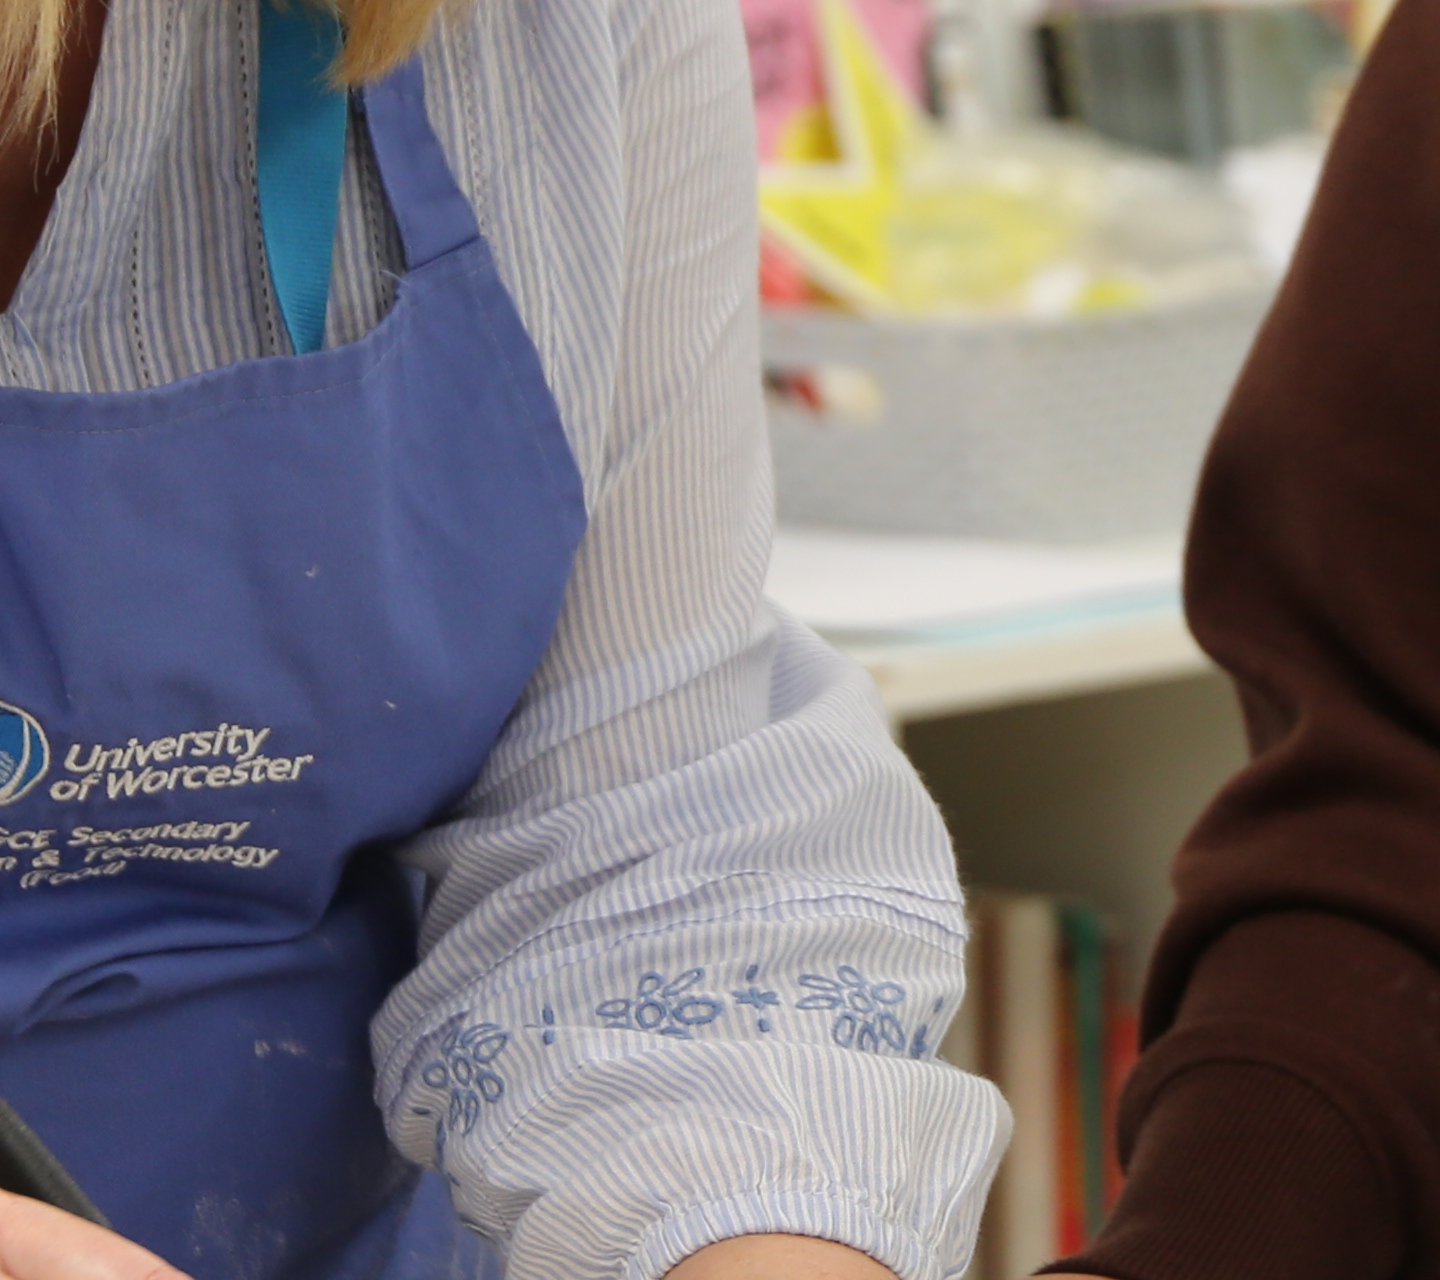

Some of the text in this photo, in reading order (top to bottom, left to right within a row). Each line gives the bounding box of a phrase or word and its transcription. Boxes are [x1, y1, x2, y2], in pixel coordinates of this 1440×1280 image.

[64, 722, 271, 773] University
[49, 754, 315, 802] of Worcester
[67, 820, 251, 847] Secondary
[32, 849, 59, 868] &
[85, 843, 279, 870] Technology
